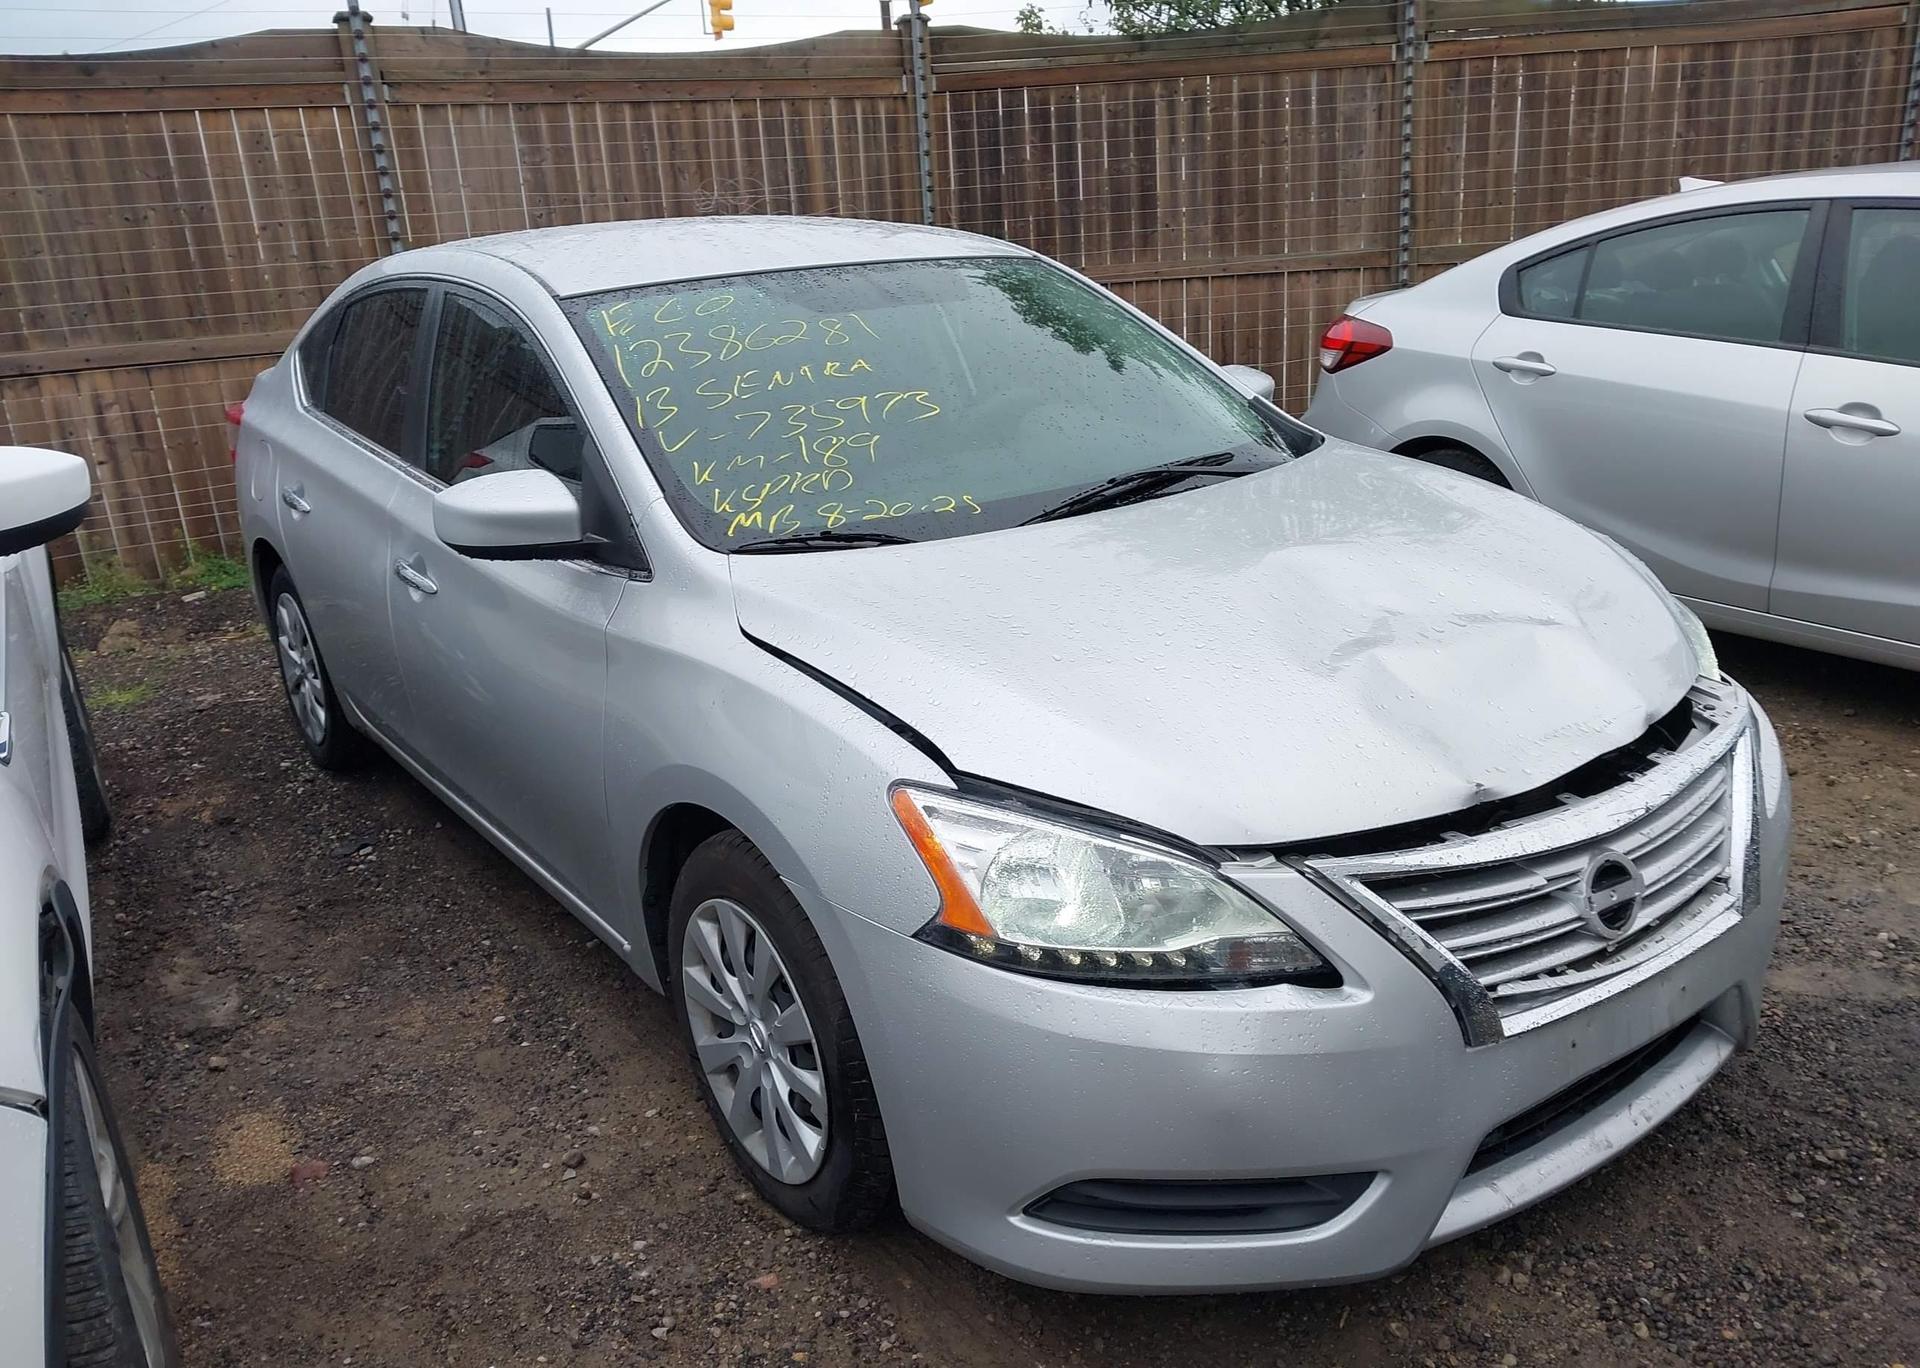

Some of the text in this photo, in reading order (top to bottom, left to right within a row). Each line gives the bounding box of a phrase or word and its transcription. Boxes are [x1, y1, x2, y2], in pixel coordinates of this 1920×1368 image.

[601, 295, 735, 337] ECO
[613, 313, 882, 389] 12386281
[635, 358, 874, 430] 13 SENTRA
[727, 503, 801, 537] MB
